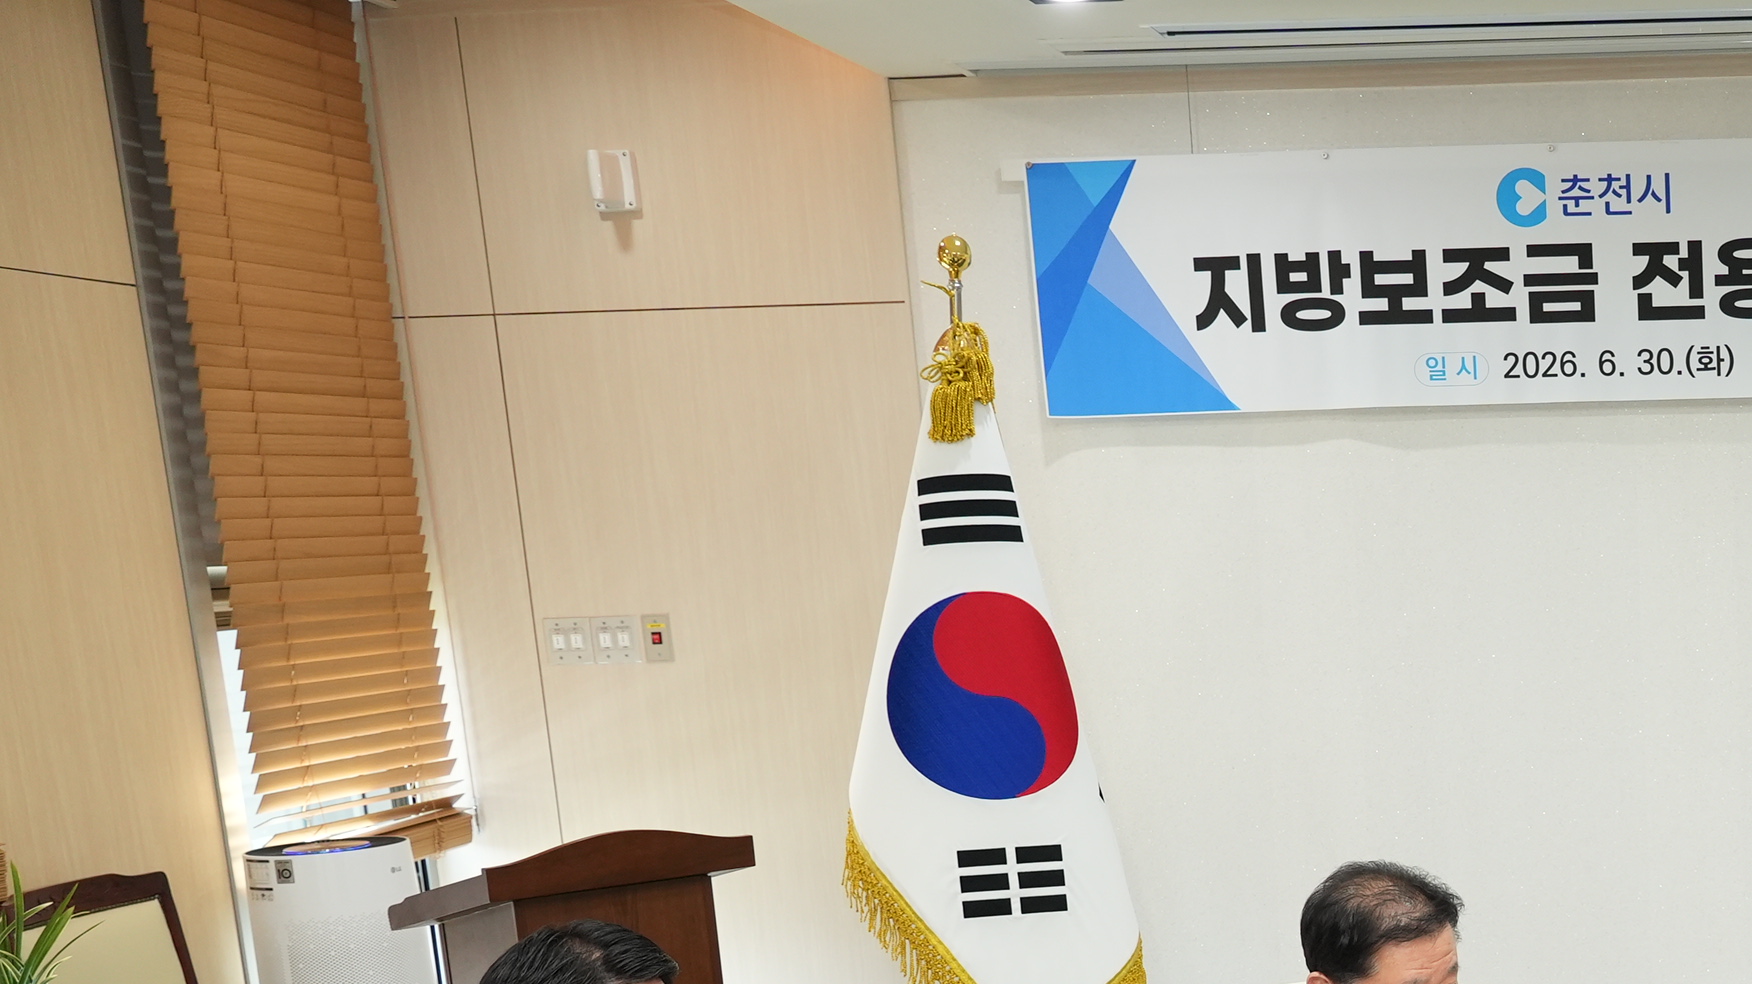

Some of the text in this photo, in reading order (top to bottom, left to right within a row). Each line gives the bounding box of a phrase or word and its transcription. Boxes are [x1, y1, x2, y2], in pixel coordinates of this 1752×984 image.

[1556, 171, 1674, 218] 춘천시
[1192, 242, 1600, 333] 지방보조금
[1502, 349, 1588, 381] 2026.
[1598, 349, 1625, 378] 6.
[1636, 344, 1736, 379] 30.(화)
